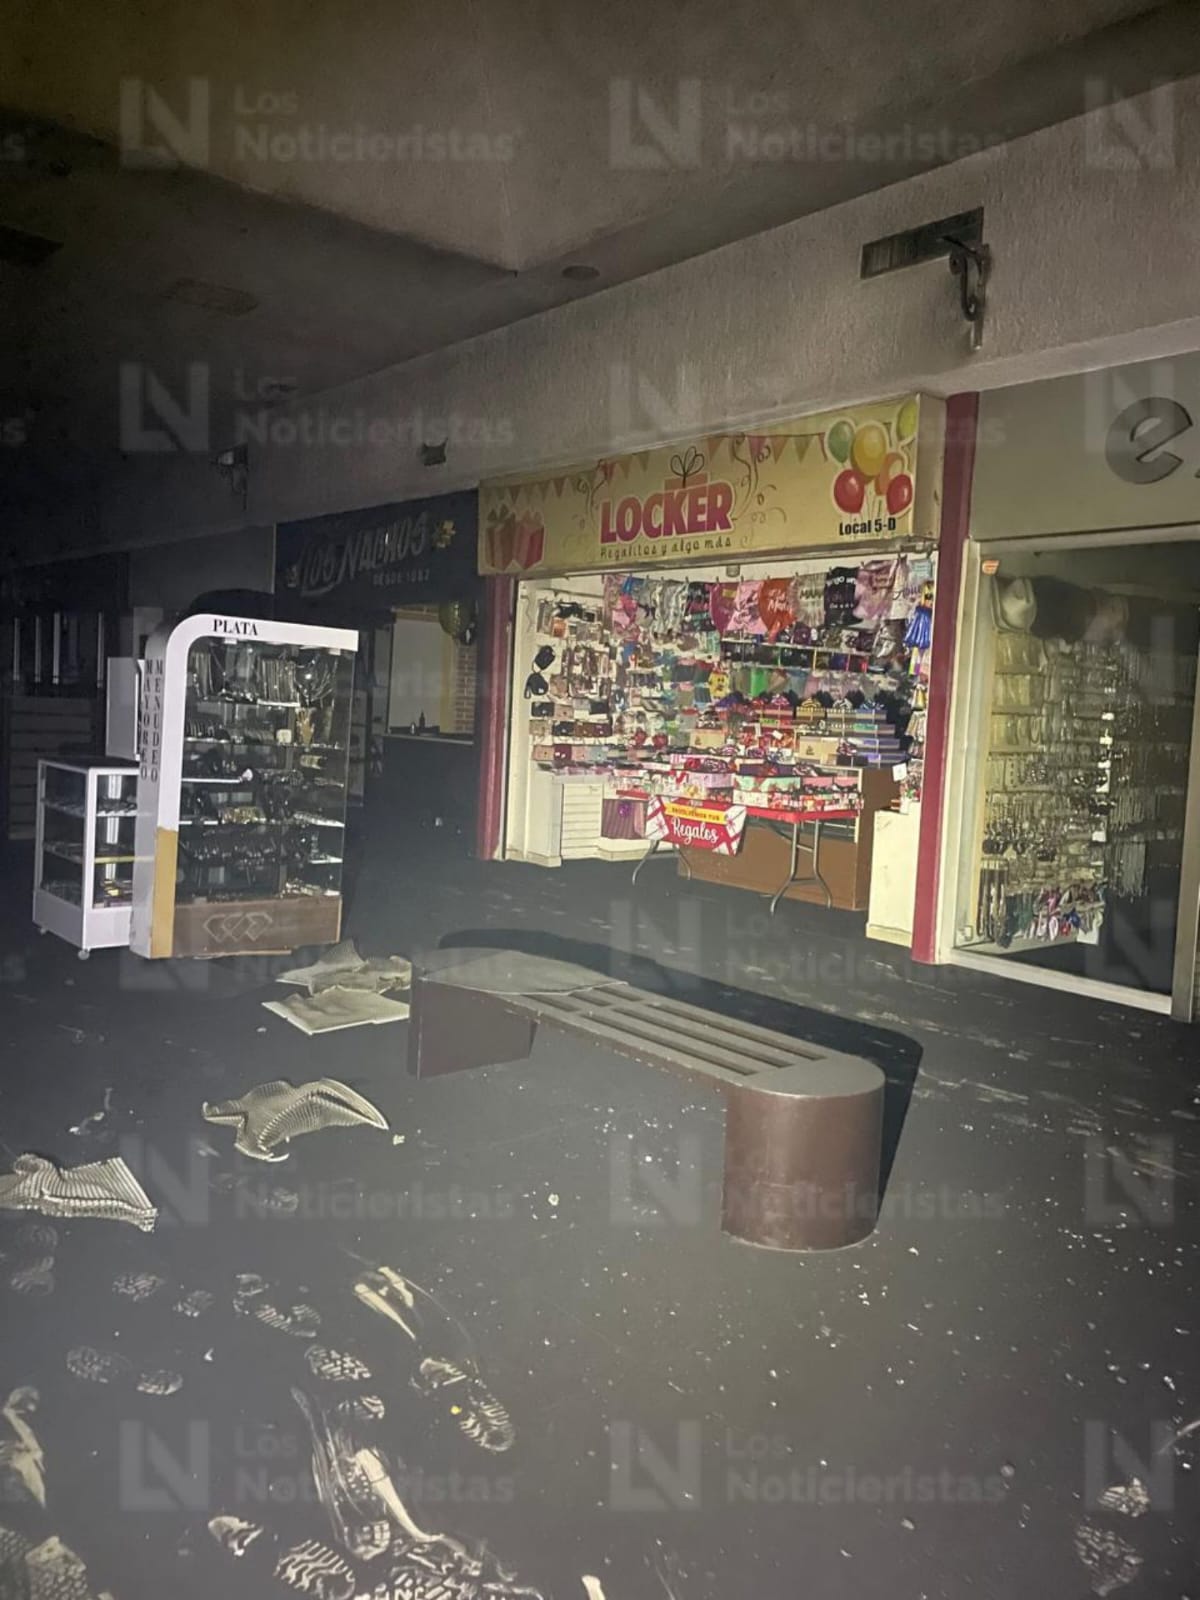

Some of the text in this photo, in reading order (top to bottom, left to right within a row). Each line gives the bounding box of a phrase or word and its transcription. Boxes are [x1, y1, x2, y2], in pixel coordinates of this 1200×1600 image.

[600, 482, 733, 544] LOCKER
[839, 519, 872, 536] Local
[600, 544, 658, 561] Regalitos
[660, 544, 668, 556] y
[671, 539, 701, 554] algo
[212, 617, 259, 636] PLATA
[140, 658, 153, 780] MAYOREO
[150, 659, 164, 784] MENUDEO
[671, 817, 720, 846] Regalos
